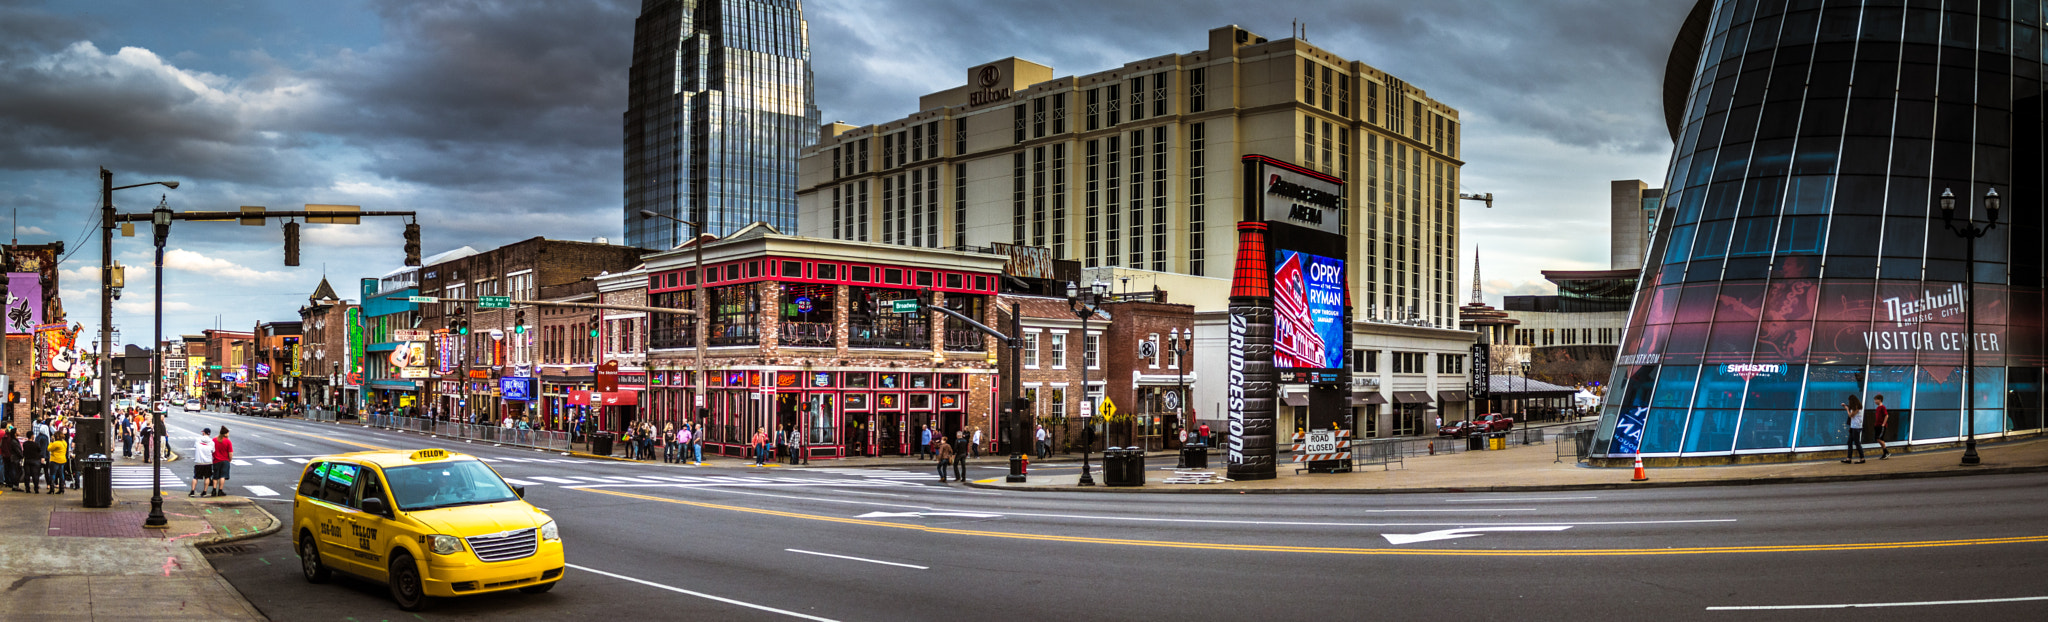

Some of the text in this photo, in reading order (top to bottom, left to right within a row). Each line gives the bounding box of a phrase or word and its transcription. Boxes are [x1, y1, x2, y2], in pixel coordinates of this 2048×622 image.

[1310, 290, 1341, 306] RYMAN
[1321, 309, 1339, 317] THROUGH
[1904, 307, 1959, 327] MUSIC CITY
[1864, 331, 1934, 351] VISITOR
[1310, 434, 1330, 443] ROAD
[418, 449, 444, 458] YELLOW
[1307, 444, 1334, 452] CLOSED
[352, 524, 378, 541] YELLOW
